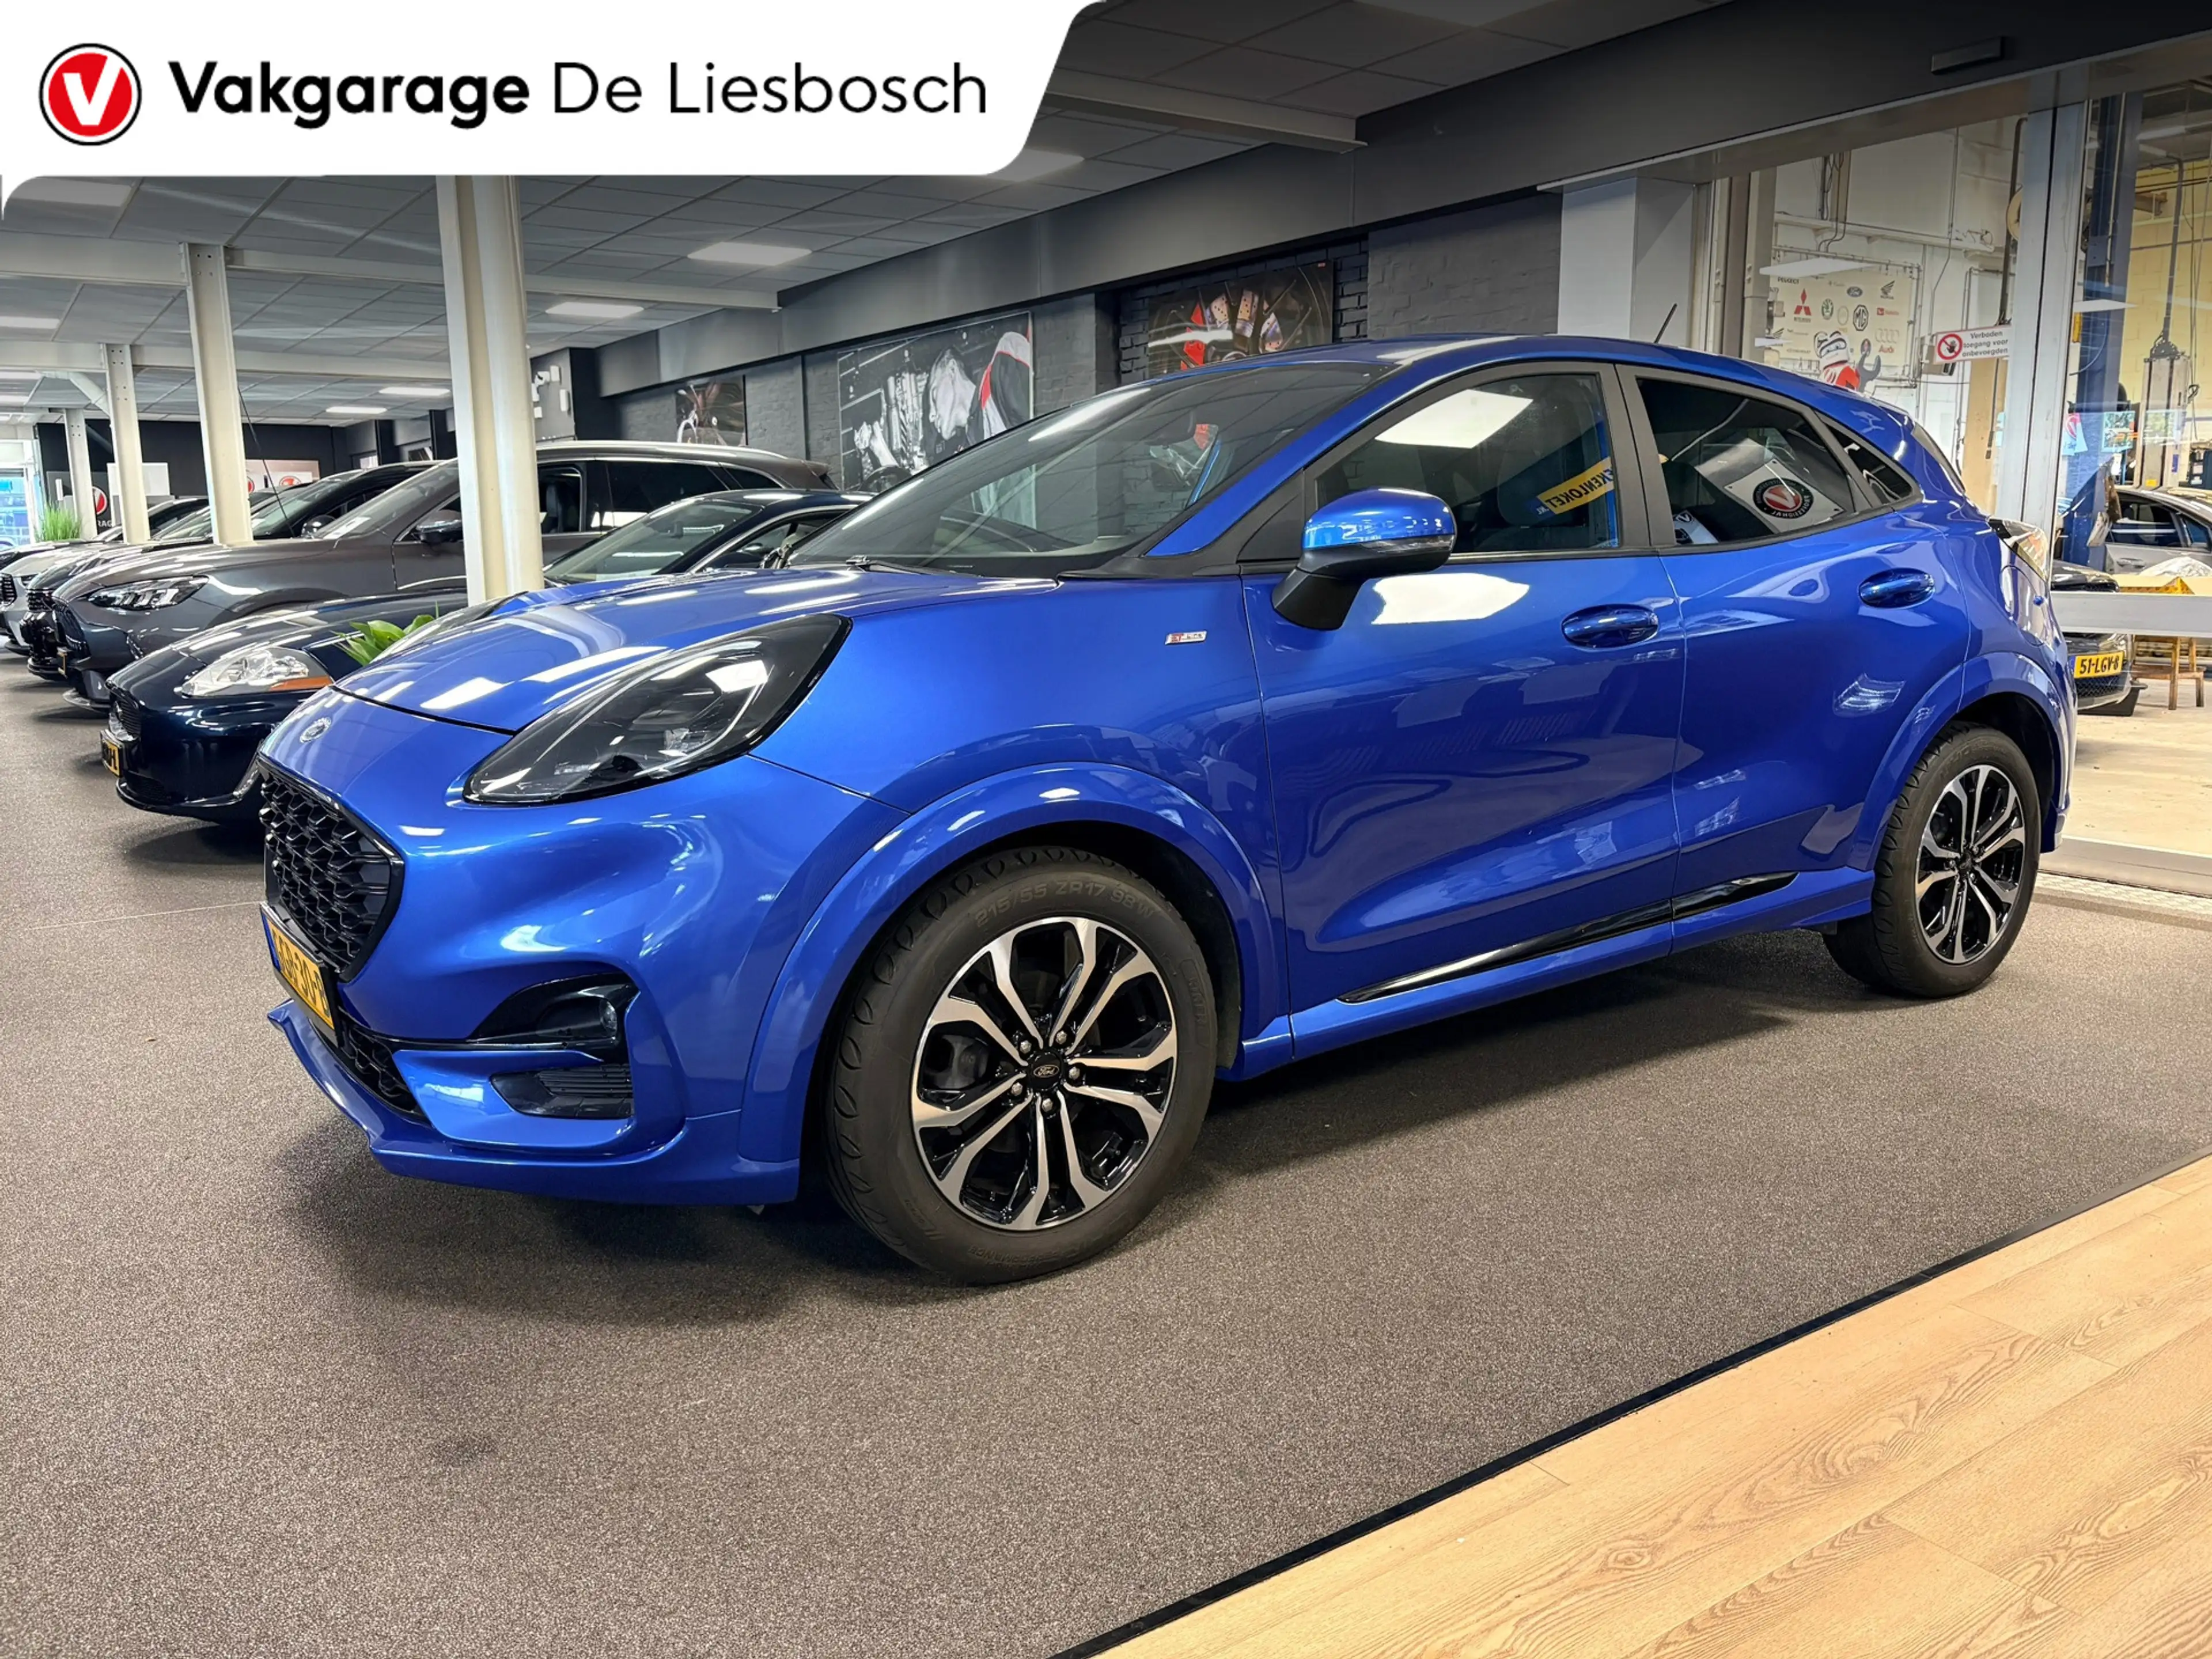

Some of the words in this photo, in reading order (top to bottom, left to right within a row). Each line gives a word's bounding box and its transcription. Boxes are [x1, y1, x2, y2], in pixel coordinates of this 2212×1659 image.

[1962, 348, 2008, 357] onbevoegden
[976, 884, 1047, 927] 215/55
[1055, 880, 1106, 896] ZR17
